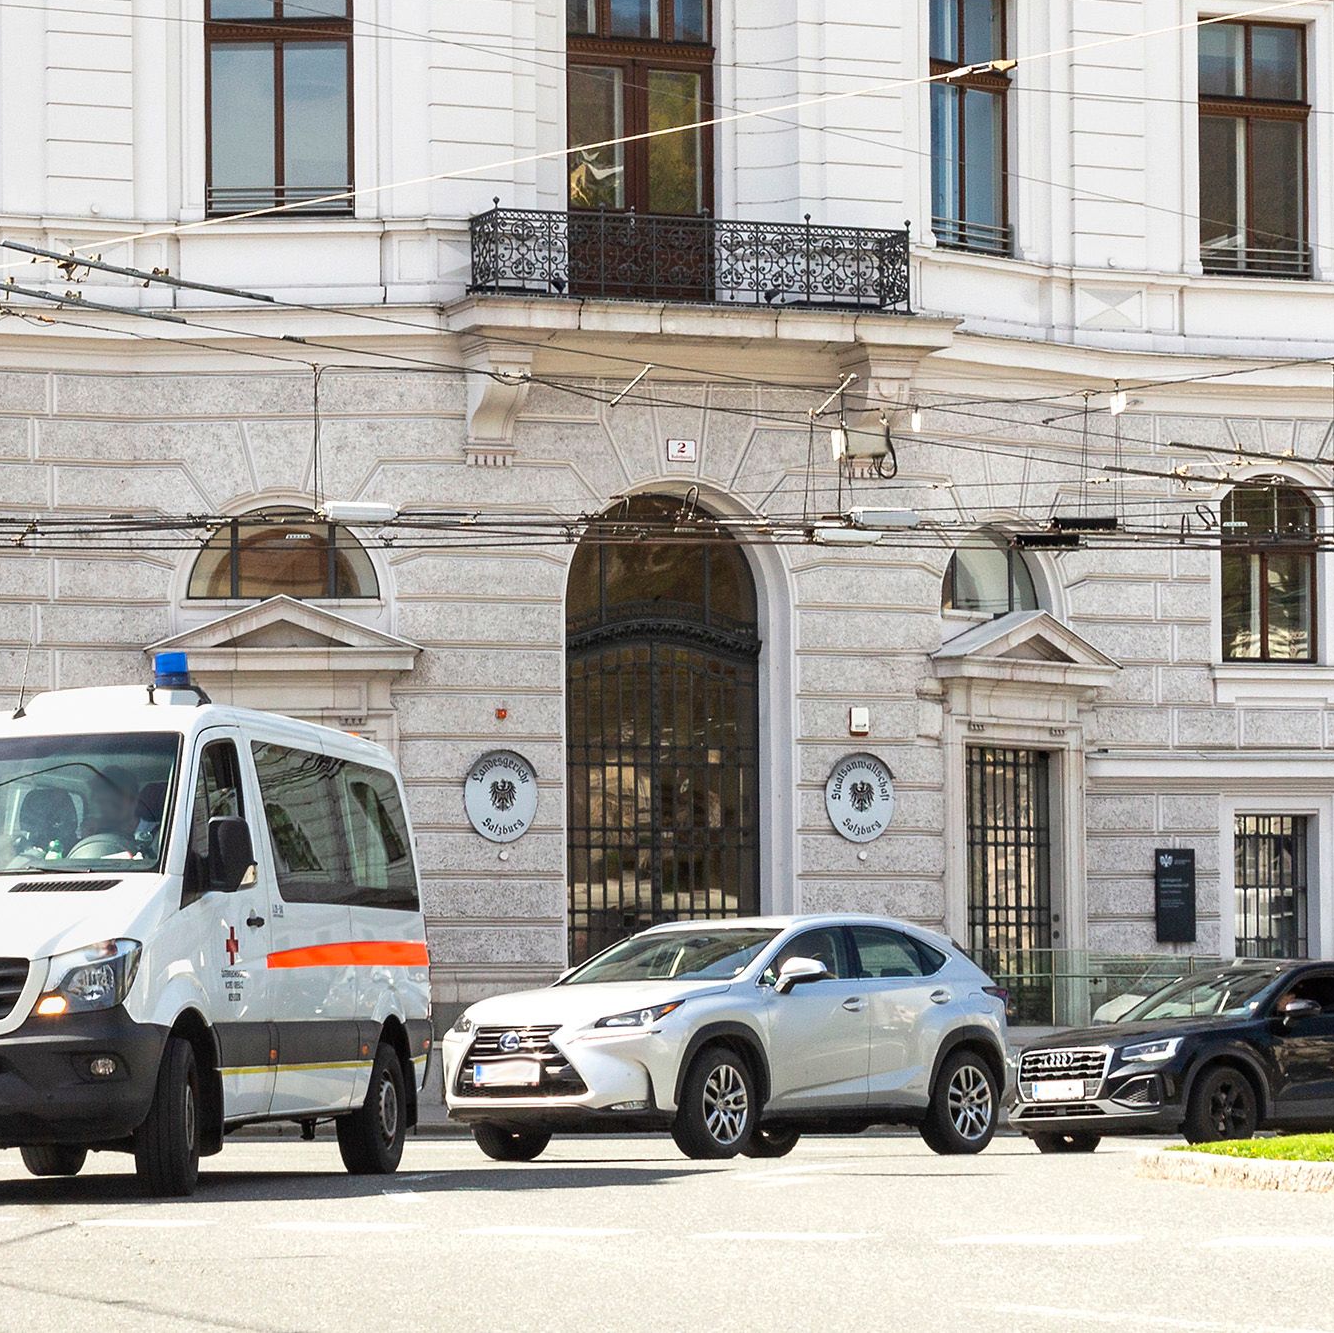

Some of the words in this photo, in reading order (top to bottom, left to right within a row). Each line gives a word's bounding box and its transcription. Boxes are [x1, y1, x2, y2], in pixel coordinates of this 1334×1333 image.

[677, 442, 686, 453] 2
[472, 757, 529, 784] Landesgericht
[831, 760, 890, 801] Staatsanwaltschaft
[481, 817, 525, 836] Salzburg
[842, 818, 882, 836] Salzburg
